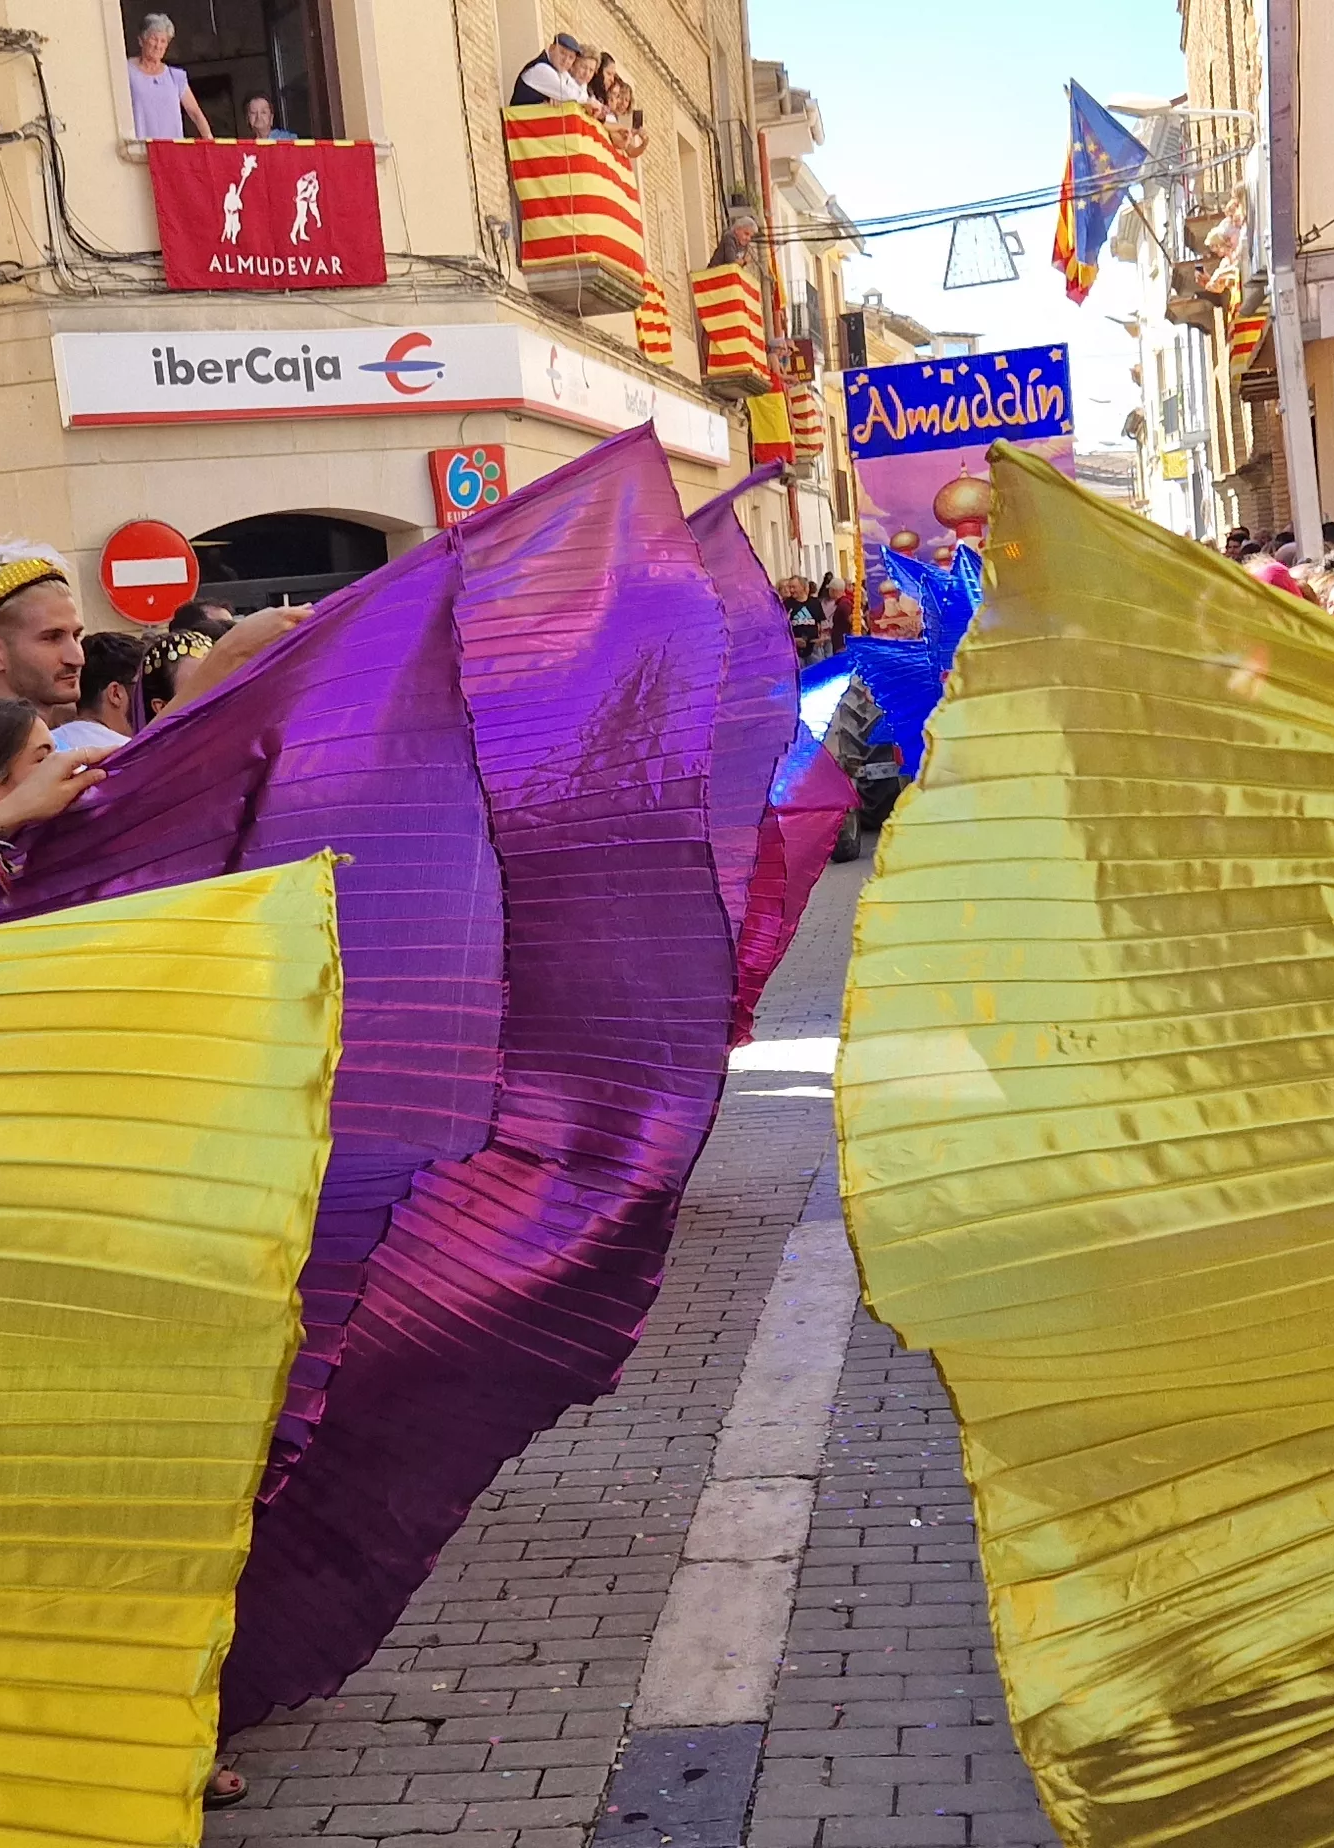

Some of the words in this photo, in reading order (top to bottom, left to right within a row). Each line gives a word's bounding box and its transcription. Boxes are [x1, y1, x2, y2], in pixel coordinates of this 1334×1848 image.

[209, 253, 343, 276] ALMUDEVAR
[152, 344, 342, 392] iberCaja
[853, 368, 1065, 444] Almuddín
